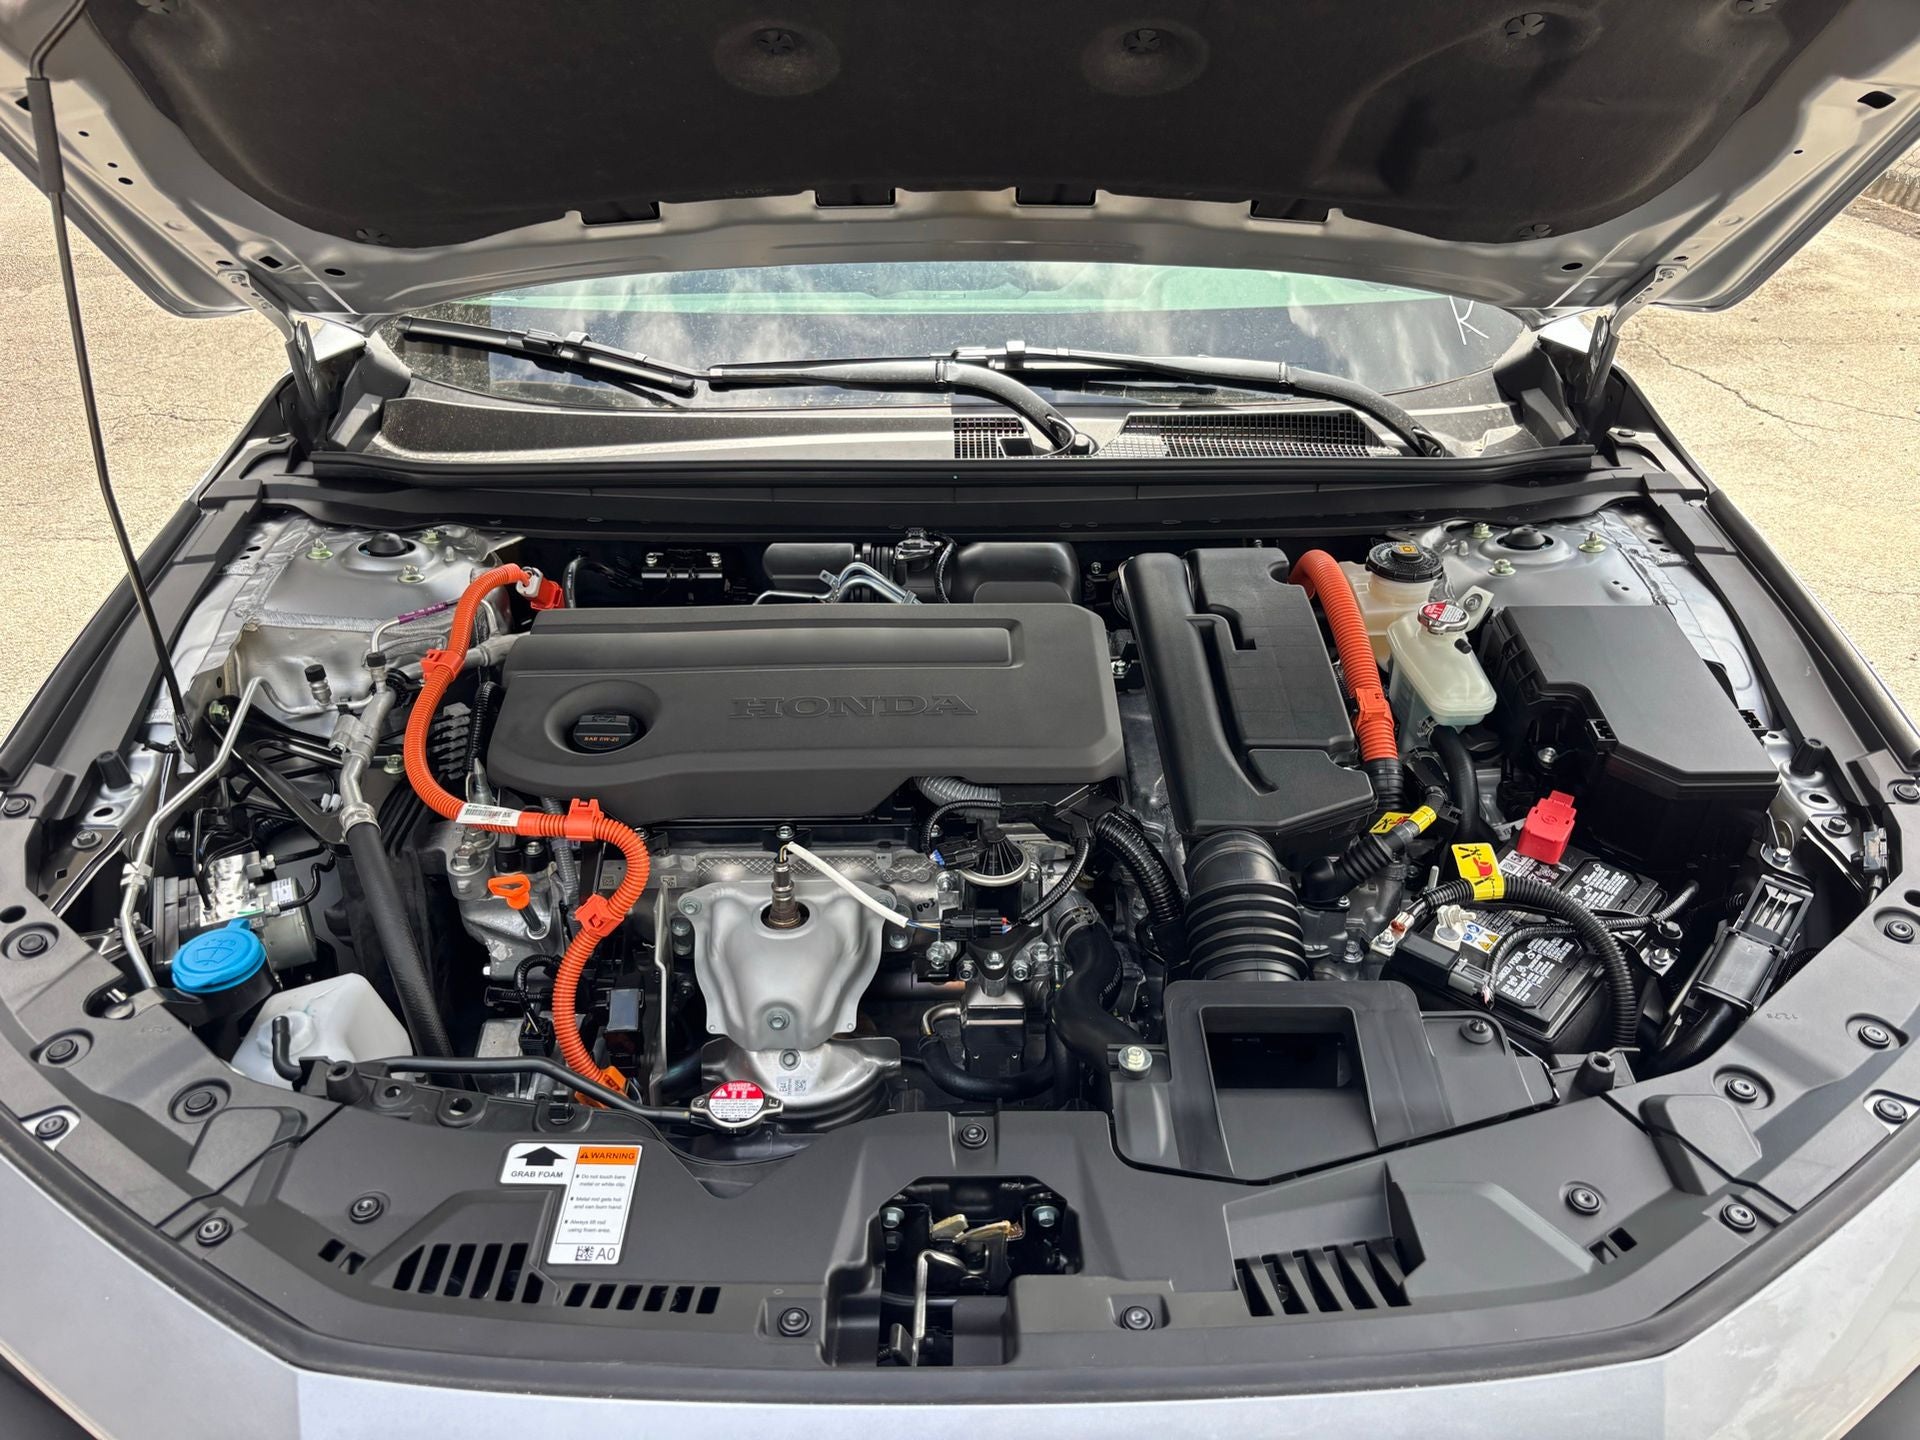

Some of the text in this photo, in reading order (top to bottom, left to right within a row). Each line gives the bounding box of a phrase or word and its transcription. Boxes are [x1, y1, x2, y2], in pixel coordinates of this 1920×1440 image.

[1448, 295, 1490, 345] K
[728, 694, 978, 719] HONDA
[591, 1152, 635, 1160] WARNING
[595, 1247, 616, 1261] A0
